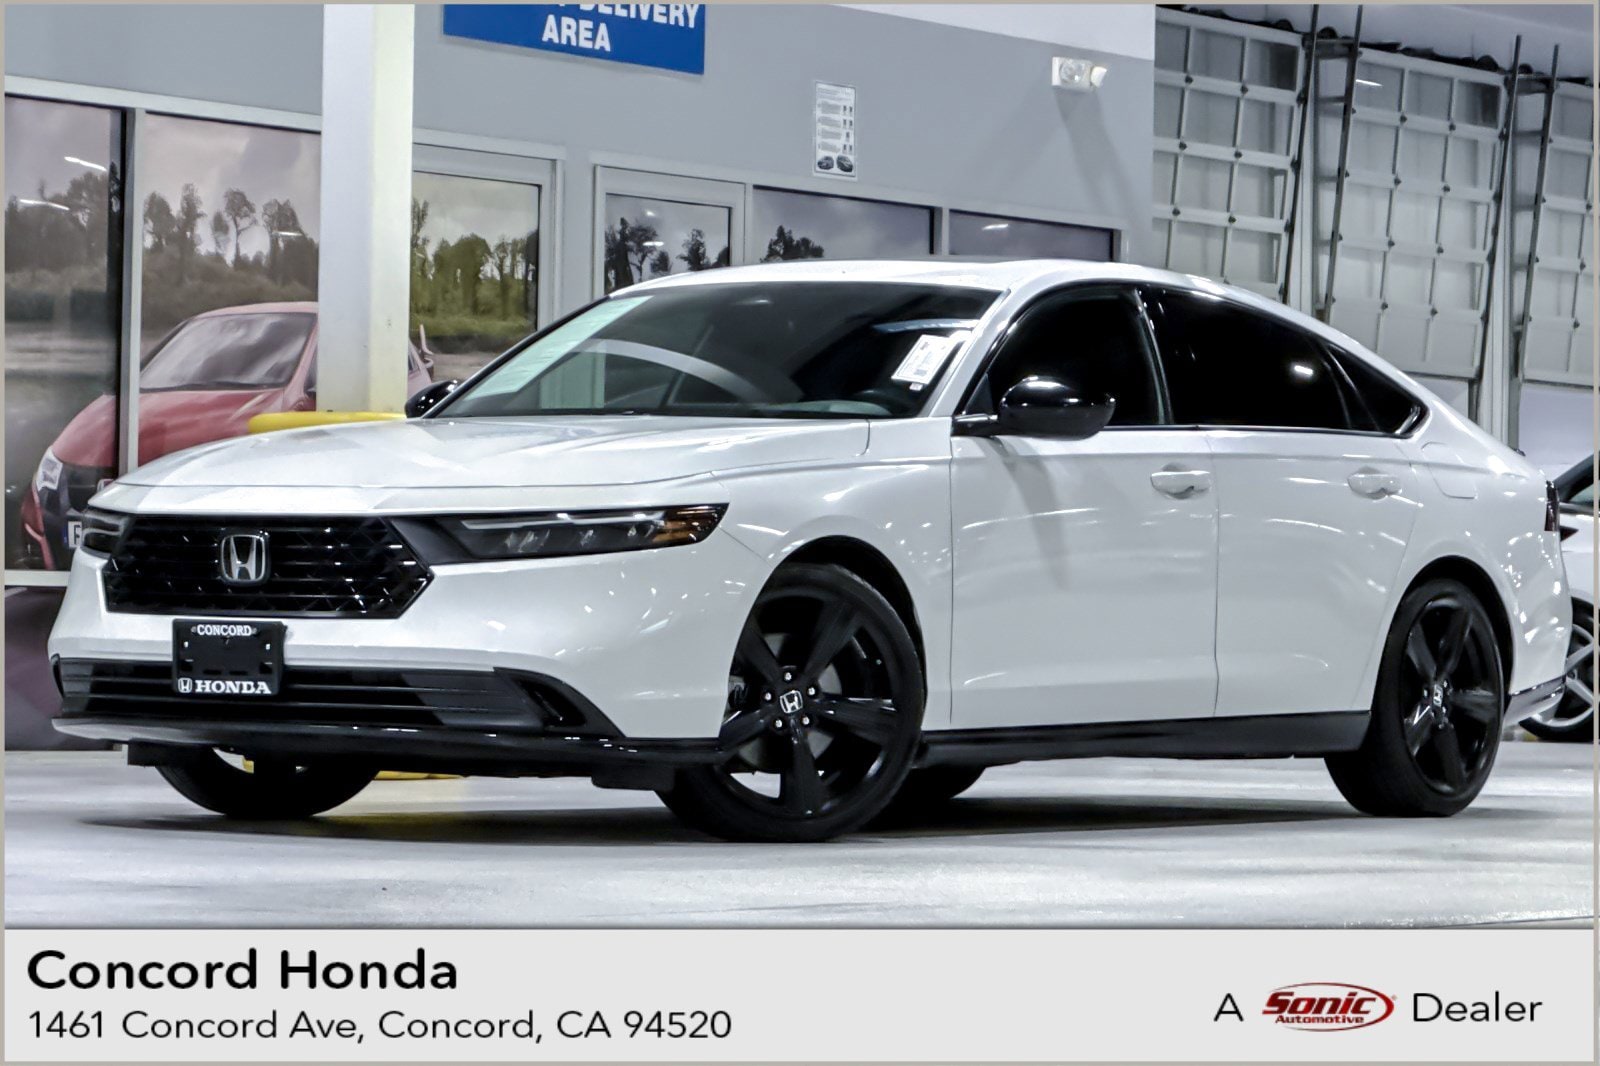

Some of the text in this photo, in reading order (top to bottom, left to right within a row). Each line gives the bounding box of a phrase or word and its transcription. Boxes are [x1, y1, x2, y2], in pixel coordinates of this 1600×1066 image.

[579, 4, 699, 29] LIVERY
[542, 14, 611, 52] AREA
[196, 624, 253, 637] CONCORD
[195, 679, 272, 695] HONDA
